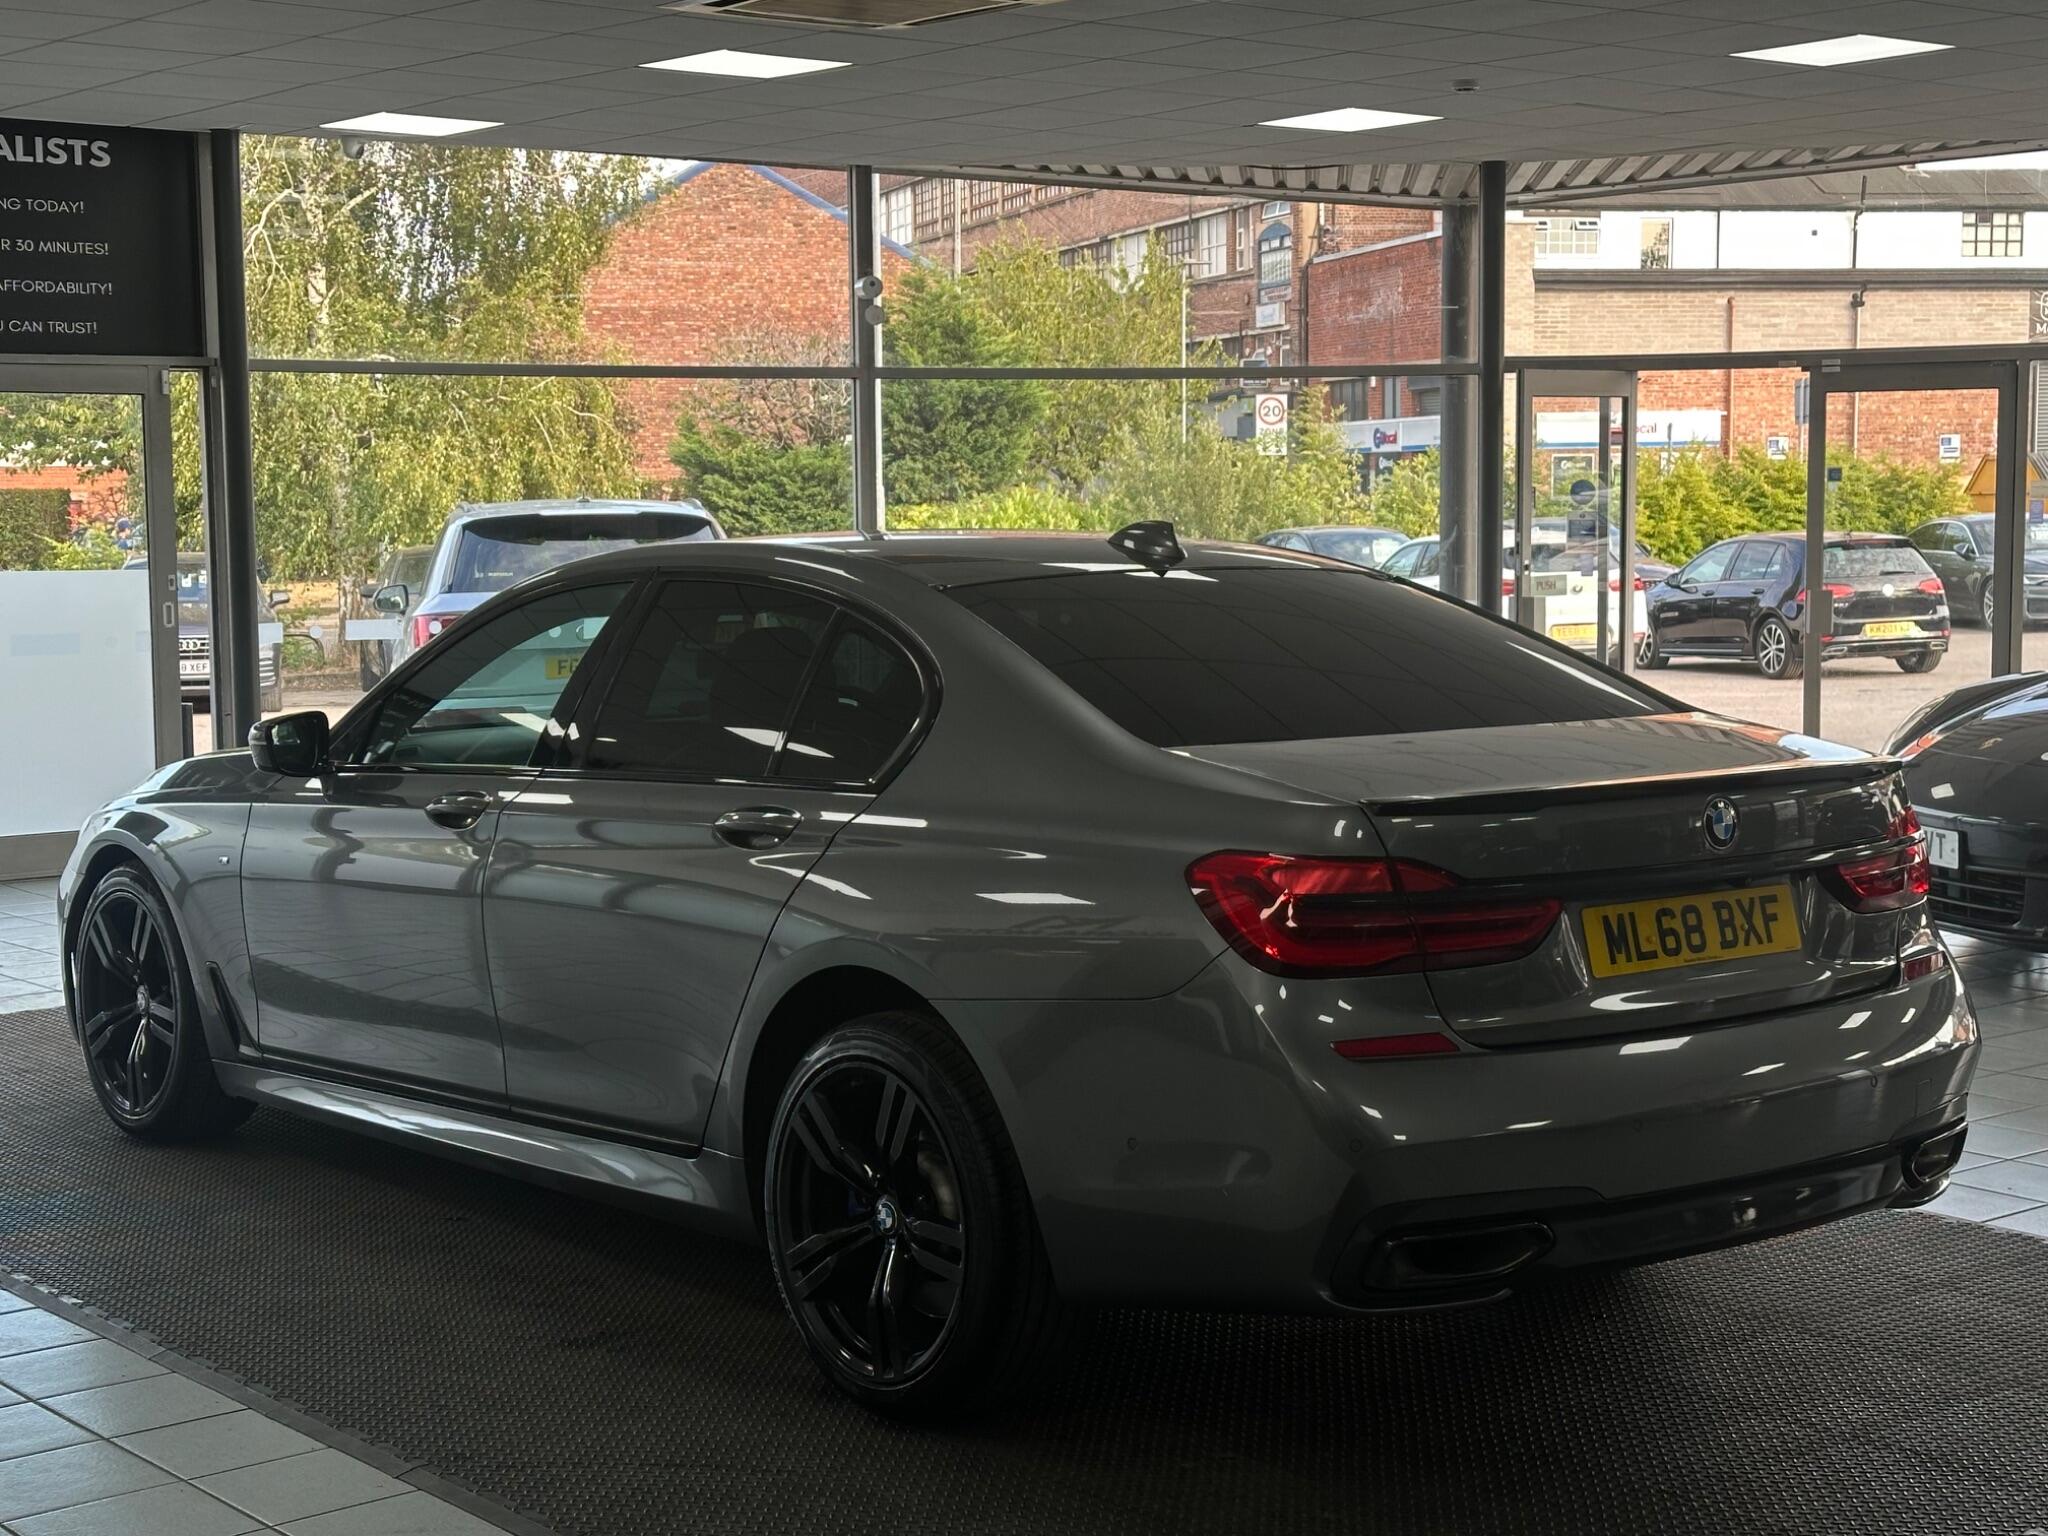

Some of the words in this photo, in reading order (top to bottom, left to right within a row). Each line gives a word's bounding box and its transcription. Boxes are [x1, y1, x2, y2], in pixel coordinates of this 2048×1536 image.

[0, 134, 111, 167] ALISTS
[25, 199, 84, 214] TODAY!
[1, 239, 11, 251] R
[15, 239, 34, 252] 30
[38, 241, 109, 255] MINUTES!
[8, 320, 43, 332] CAN
[47, 321, 97, 334] TRUST!
[1262, 405, 1281, 417] 20
[1536, 580, 1557, 592] PUSH
[190, 662, 208, 672] XEF
[1602, 904, 1707, 965] ML68
[1712, 894, 1779, 950] BXF
